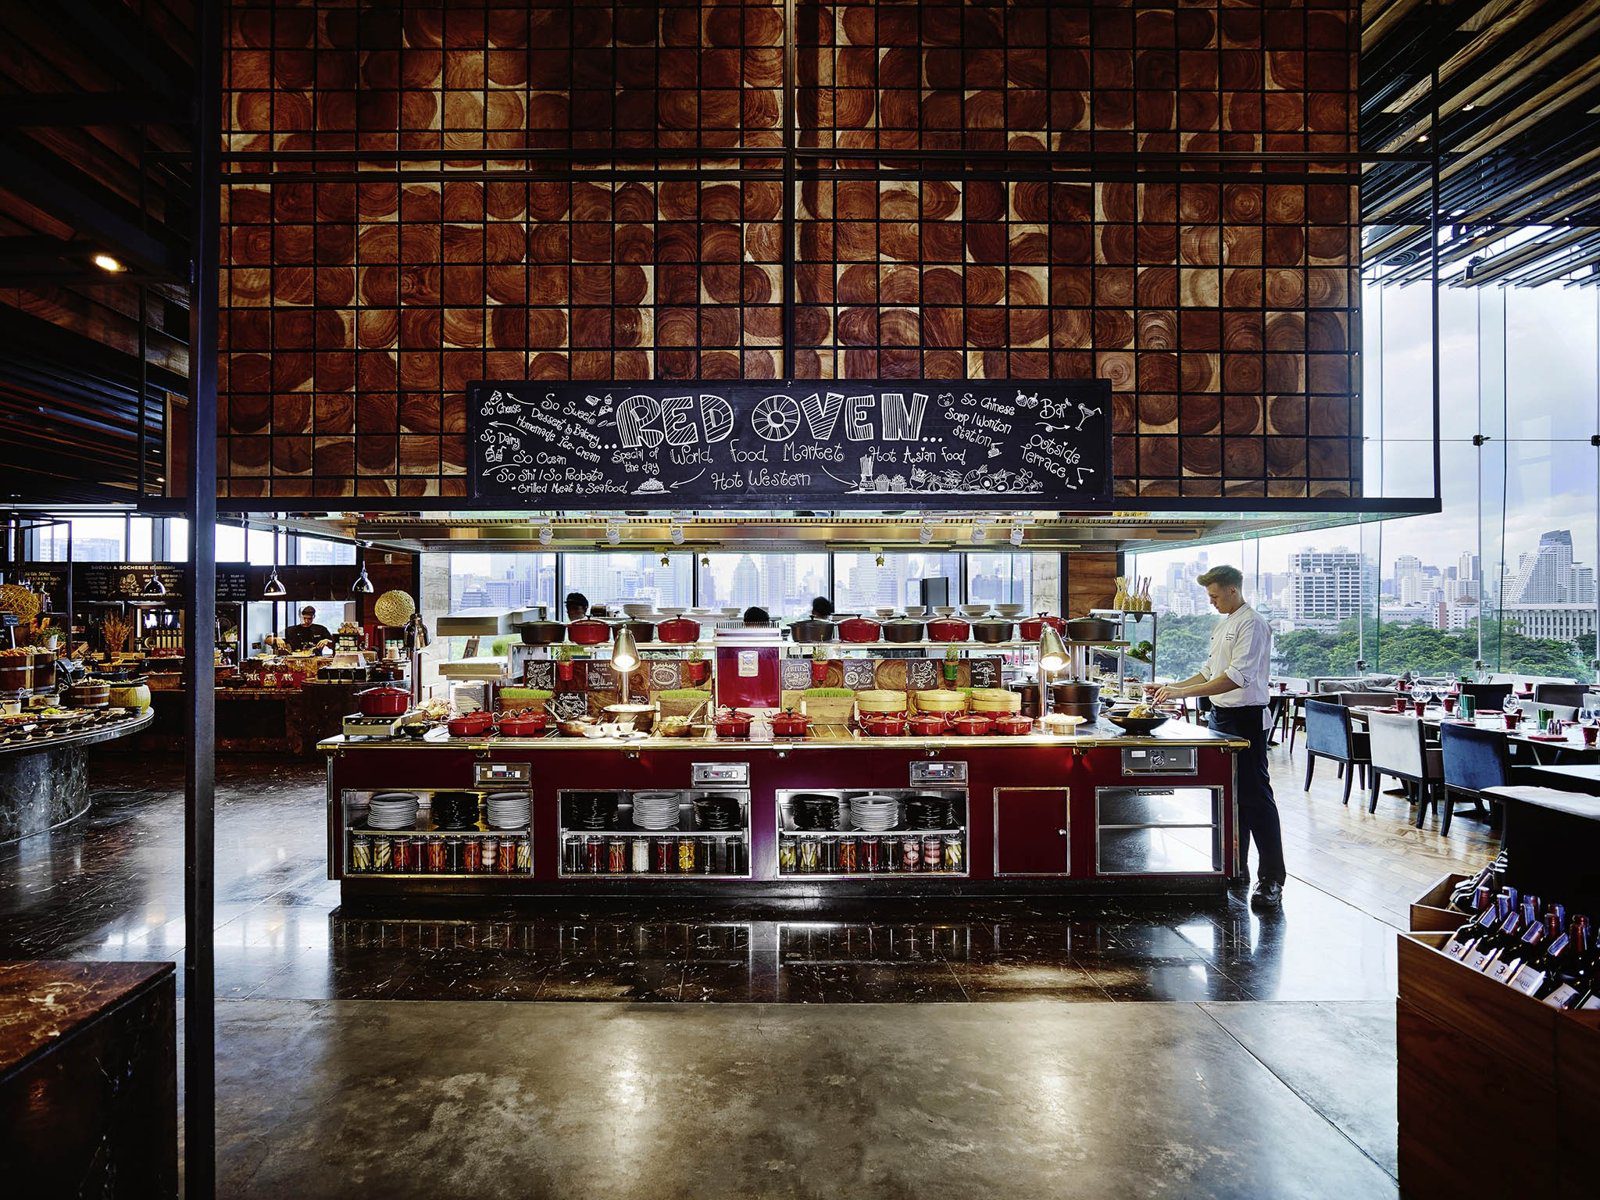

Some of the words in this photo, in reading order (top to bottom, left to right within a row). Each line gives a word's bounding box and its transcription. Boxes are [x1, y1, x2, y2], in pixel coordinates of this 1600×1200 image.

[480, 401, 494, 416] So
[540, 393, 560, 410] So
[562, 401, 596, 425] Sweet
[960, 392, 977, 406] So
[980, 397, 1015, 416] Chinese
[1039, 398, 1066, 419] Bar
[480, 428, 496, 443] So
[497, 431, 521, 450] Dairy
[531, 407, 567, 431] Dessert
[572, 423, 601, 449] Bakery
[952, 425, 993, 448] Station
[516, 415, 556, 442] Homemade
[575, 446, 601, 464] Cream
[1030, 433, 1081, 465] Outside
[512, 450, 533, 464] So
[536, 452, 567, 465] Ocean
[611, 448, 644, 464] Special
[649, 447, 660, 460] of
[669, 444, 714, 465] World
[782, 441, 845, 462] Market
[868, 446, 897, 463] Hot
[902, 446, 936, 464] Asian
[1020, 442, 1067, 478] Terrace
[496, 467, 516, 483] So
[565, 467, 604, 481] Robata
[624, 461, 640, 473] the
[641, 461, 660, 475] day
[551, 483, 574, 494] Meat
[575, 483, 583, 494] &
[585, 479, 628, 494] Seafood
[710, 471, 744, 491] Hot
[749, 468, 811, 487] Western
